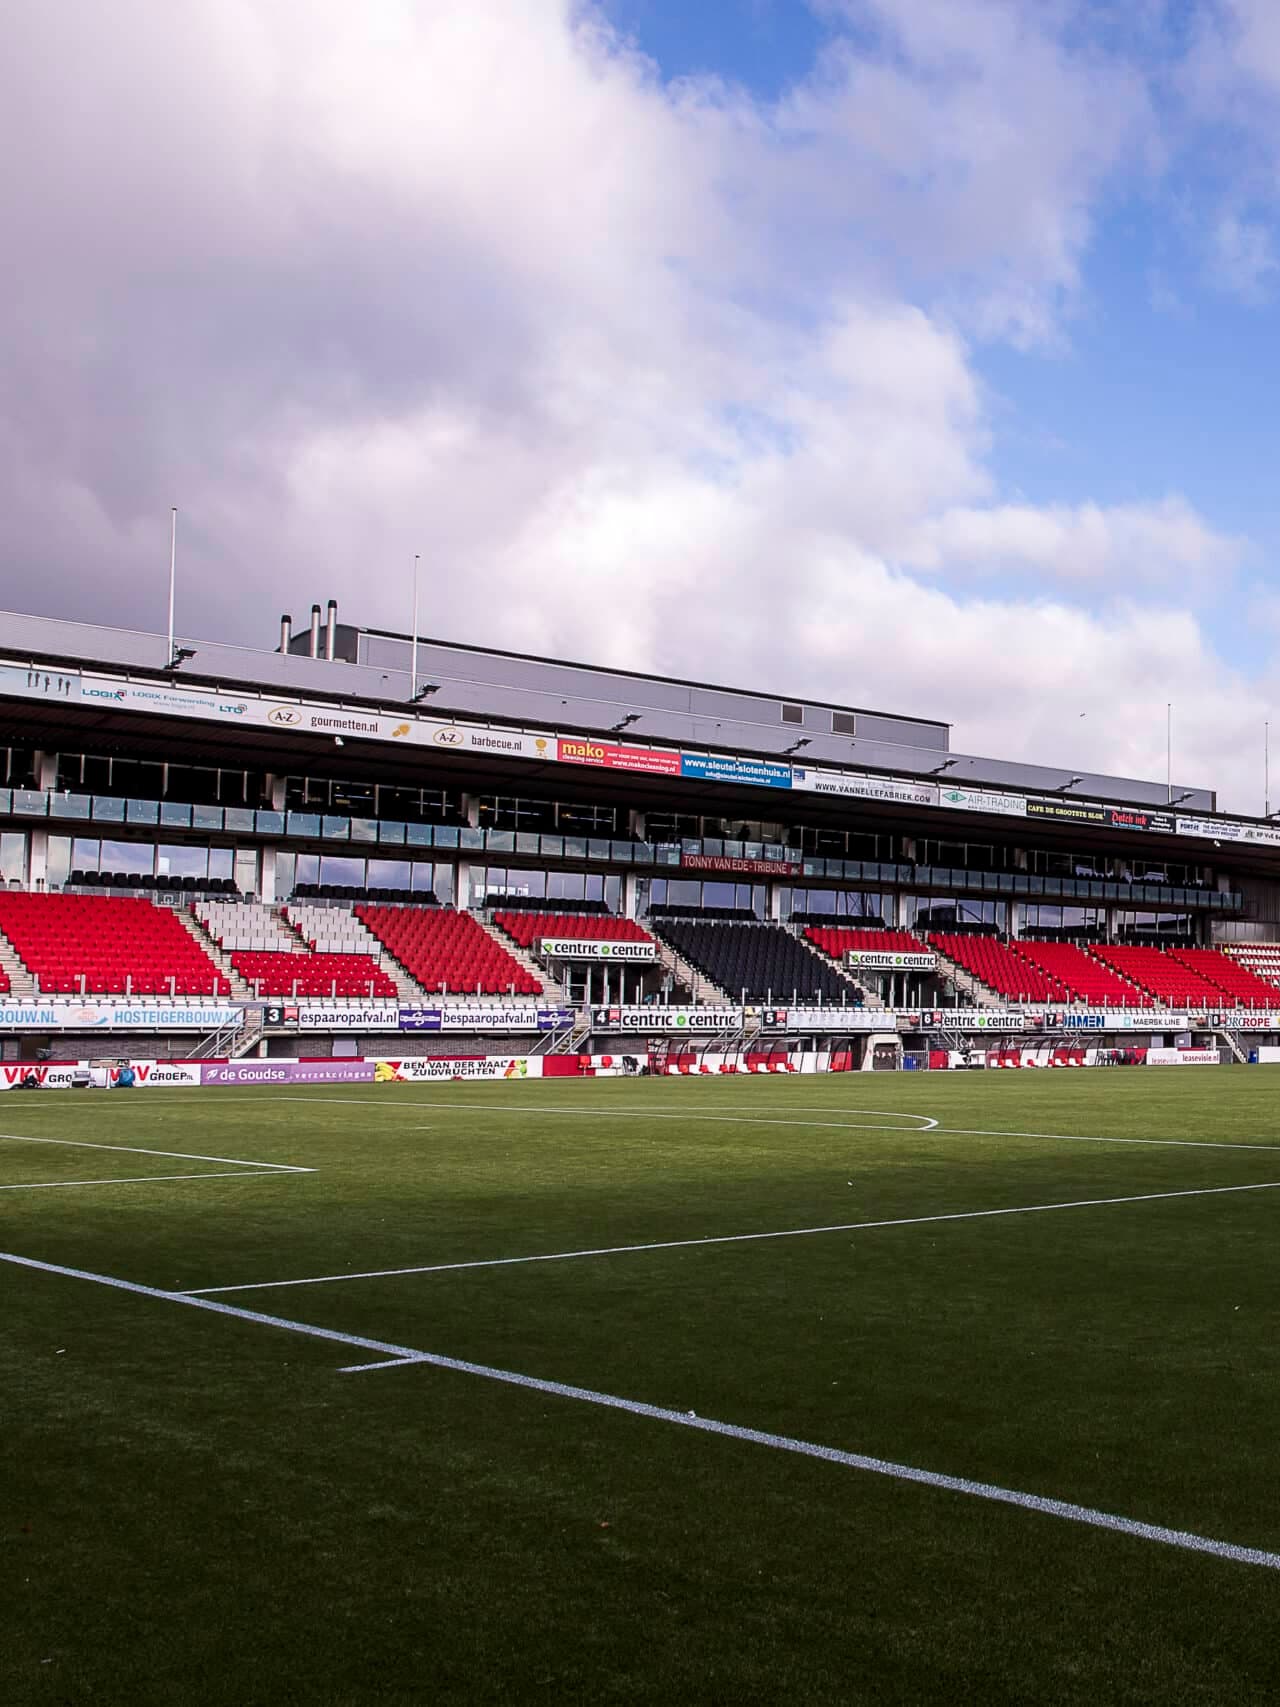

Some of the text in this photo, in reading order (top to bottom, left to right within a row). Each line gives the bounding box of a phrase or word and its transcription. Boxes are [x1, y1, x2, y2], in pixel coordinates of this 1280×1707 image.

[82, 689, 123, 701] LOGIX
[311, 715, 378, 733] gourmetten.nl
[471, 735, 522, 751] barbecue.nl
[562, 743, 604, 758] mako
[685, 759, 790, 778] www.sleutel-slotenhuis.nl
[968, 795, 1025, 810] AIR-TRADING
[684, 855, 731, 869] TONNY VAN
[554, 942, 598, 954] centric
[612, 944, 653, 956] centric
[860, 954, 893, 965] centric
[904, 955, 934, 966] centric
[268, 1009, 280, 1022] 3
[443, 1011, 536, 1026] bespaaropafval.nl
[597, 1013, 606, 1023] 4
[622, 1013, 672, 1026] centric
[689, 1013, 735, 1026] centric
[766, 1013, 774, 1023] 5
[924, 1014, 931, 1024] 6
[987, 1016, 1022, 1026] centric
[1049, 1015, 1055, 1025] 7
[1133, 1018, 1163, 1026] MAERSK
[478, 1061, 506, 1069] WAAL
[110, 1066, 150, 1082] VV
[220, 1070, 236, 1080] de
[238, 1068, 286, 1081] Goudse
[412, 1068, 496, 1076] ZUIDVRUCHTEN
